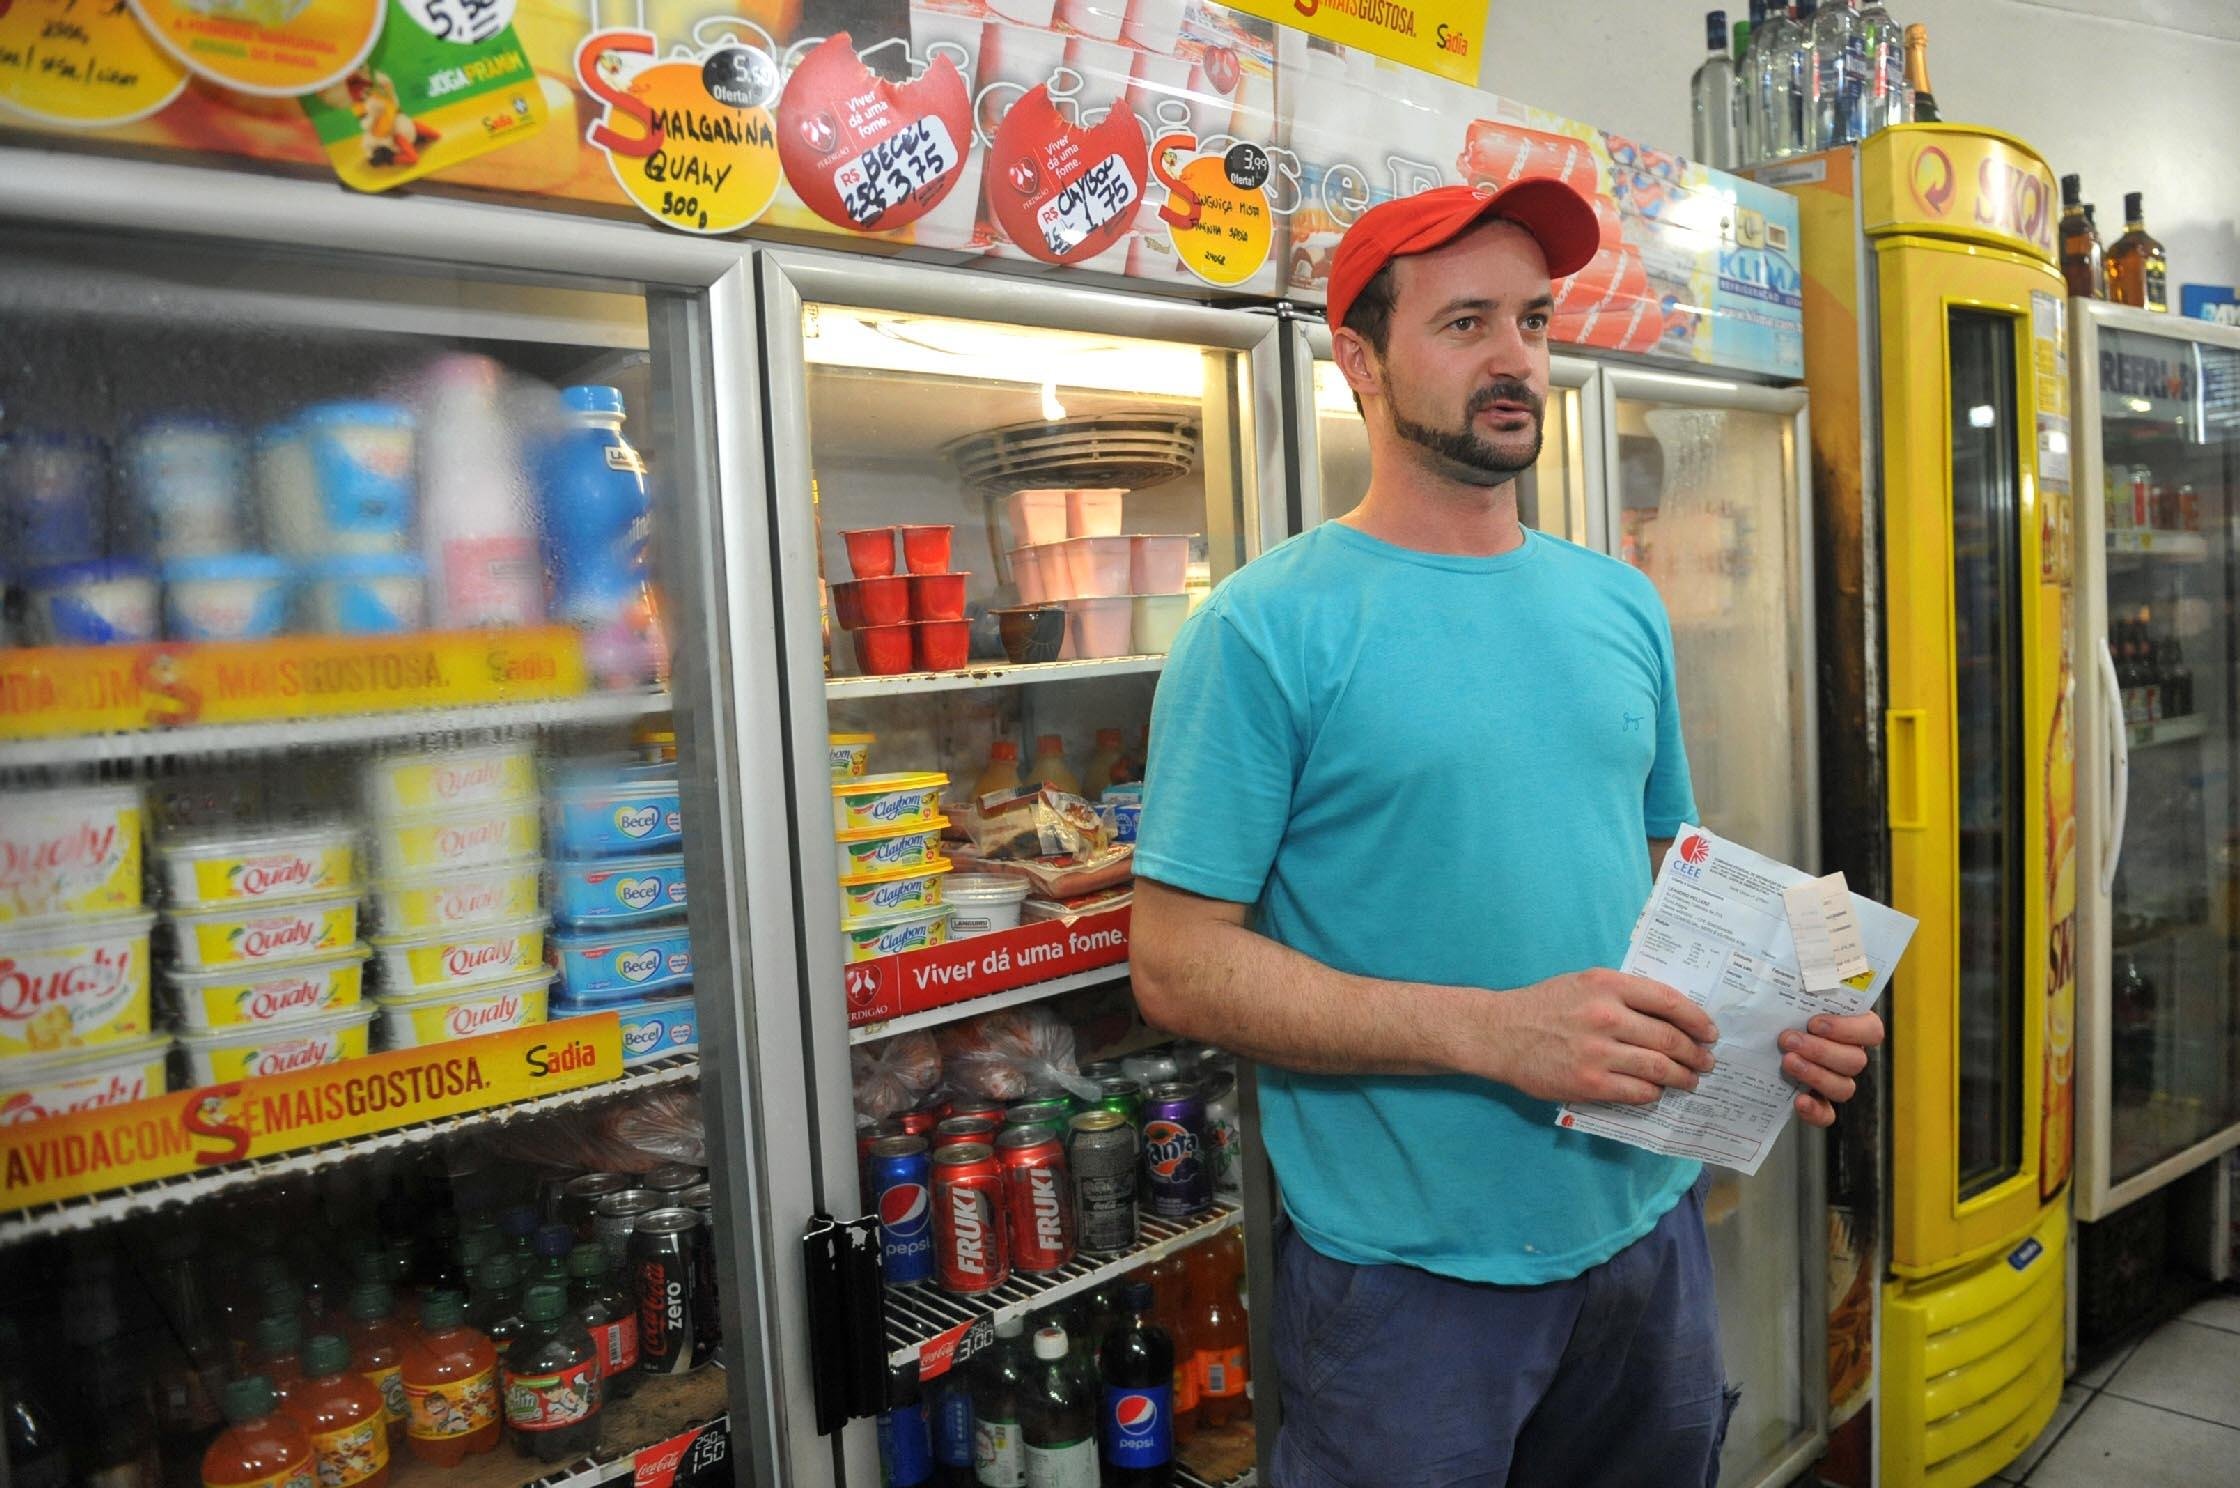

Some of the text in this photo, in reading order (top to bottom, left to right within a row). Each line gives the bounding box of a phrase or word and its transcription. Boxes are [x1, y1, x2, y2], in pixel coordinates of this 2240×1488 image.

[1436, 23, 1468, 56] Sadia
[846, 91, 876, 112] Viver
[864, 101, 889, 120] uma
[858, 117, 892, 139] fome.
[1044, 135, 1070, 155] Viver
[1047, 144, 1080, 171] dá uma
[644, 149, 732, 193] QUALY
[1055, 158, 1082, 179] fome.
[1243, 149, 1268, 171] 3.99
[840, 168, 861, 187] R$
[1230, 173, 1255, 187] Oferta!
[1042, 206, 1060, 223] R$
[1975, 157, 2051, 248] SKOL
[873, 794, 921, 820] Claybom
[621, 813, 655, 829] Becel
[876, 835, 924, 862] Claybom
[243, 858, 312, 895] Qualy
[1673, 859, 1702, 879] CEEE
[623, 884, 657, 900] Becel
[873, 881, 922, 908] Claybom
[245, 920, 314, 957] Qualy
[878, 925, 927, 953] Claybom
[449, 939, 515, 976] Qualy
[623, 956, 657, 973] Becel
[912, 927, 1128, 990] Viver dá uma fome.
[252, 981, 320, 1019] Qualy
[453, 995, 518, 1035] Qualy
[625, 1027, 659, 1046] Becel
[259, 1041, 328, 1076] Qualy
[525, 1040, 597, 1078] Sadia
[1148, 1133, 1199, 1166] anta
[1029, 1167, 1064, 1251] FRUKI
[951, 1186, 984, 1276] FRUKI
[885, 1236, 931, 1257] pepsi
[667, 1281, 683, 1331] zero
[1119, 1438, 1155, 1450] pepsi
[636, 1451, 679, 1480] Coca-Cola
